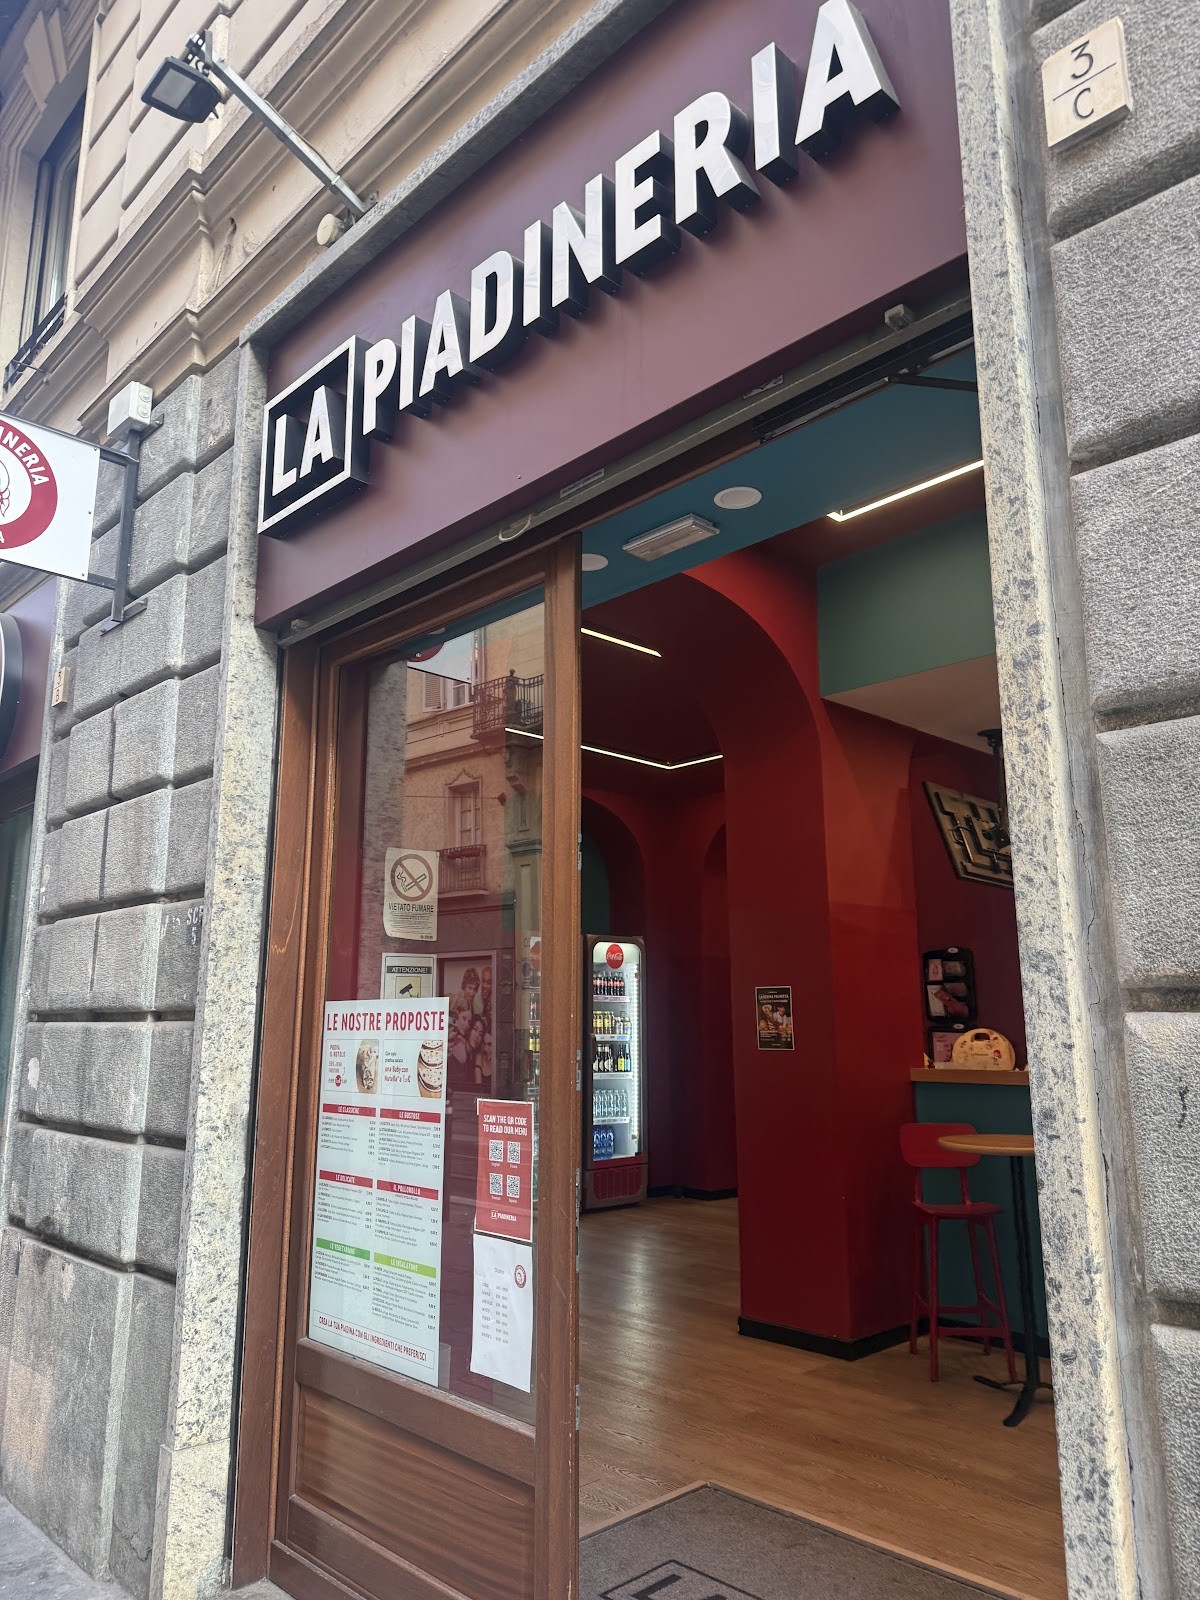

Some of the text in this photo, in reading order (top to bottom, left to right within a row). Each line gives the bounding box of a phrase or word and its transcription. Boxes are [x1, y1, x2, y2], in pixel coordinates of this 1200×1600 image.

[1070, 39, 1094, 79] 3
[1073, 87, 1094, 120] C
[272, 0, 884, 497] LA PIADINERIA
[389, 902, 434, 913] VIETATO FUMARE
[391, 966, 428, 974] ATTENZIONE!
[326, 1010, 445, 1031] LE NOSTRE PROPOSTE
[483, 1115, 496, 1123] SCAN
[497, 1116, 507, 1124] THE
[515, 1117, 527, 1126] CODE
[483, 1124, 528, 1136] TO READ OUR MENU
[340, 1323, 355, 1335] PIADINA
[403, 1345, 427, 1361] PREFERISCI
